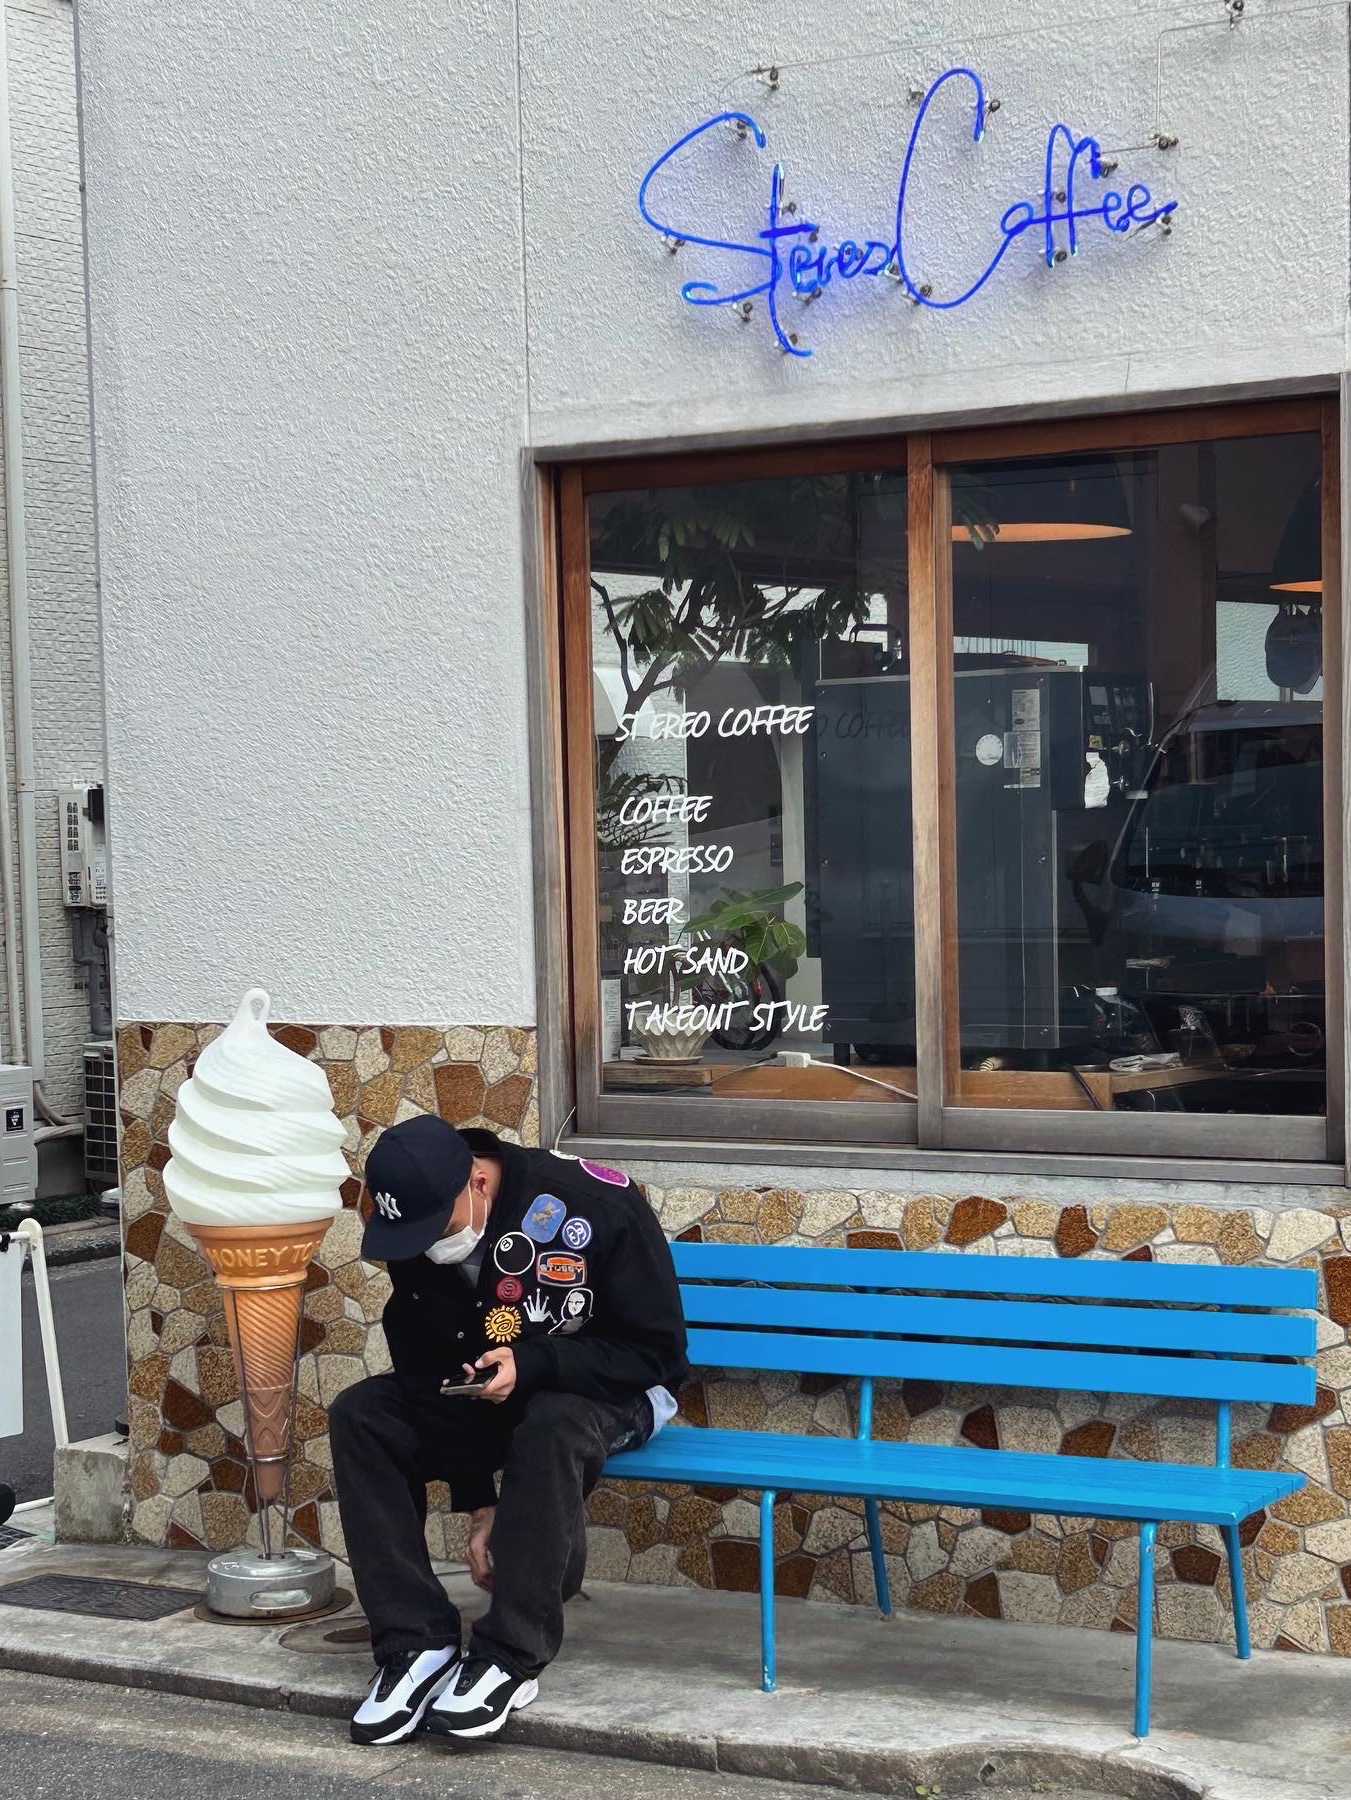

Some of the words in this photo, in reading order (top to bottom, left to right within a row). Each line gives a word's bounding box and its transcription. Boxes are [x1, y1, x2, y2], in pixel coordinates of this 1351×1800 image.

[893, 68, 1179, 309] Coffee
[615, 710, 711, 742] STEREO
[718, 704, 815, 738] COFFEE
[619, 793, 713, 825] COFFEE
[620, 845, 734, 875] ESPRESSO
[622, 897, 686, 925] BEER
[623, 944, 684, 975] HOT
[625, 1000, 749, 1037] TAKEOUT
[750, 1000, 830, 1032] STYLE
[375, 1191, 402, 1220] NY
[205, 1246, 289, 1268] HONEY
[293, 1240, 321, 1265] TO
